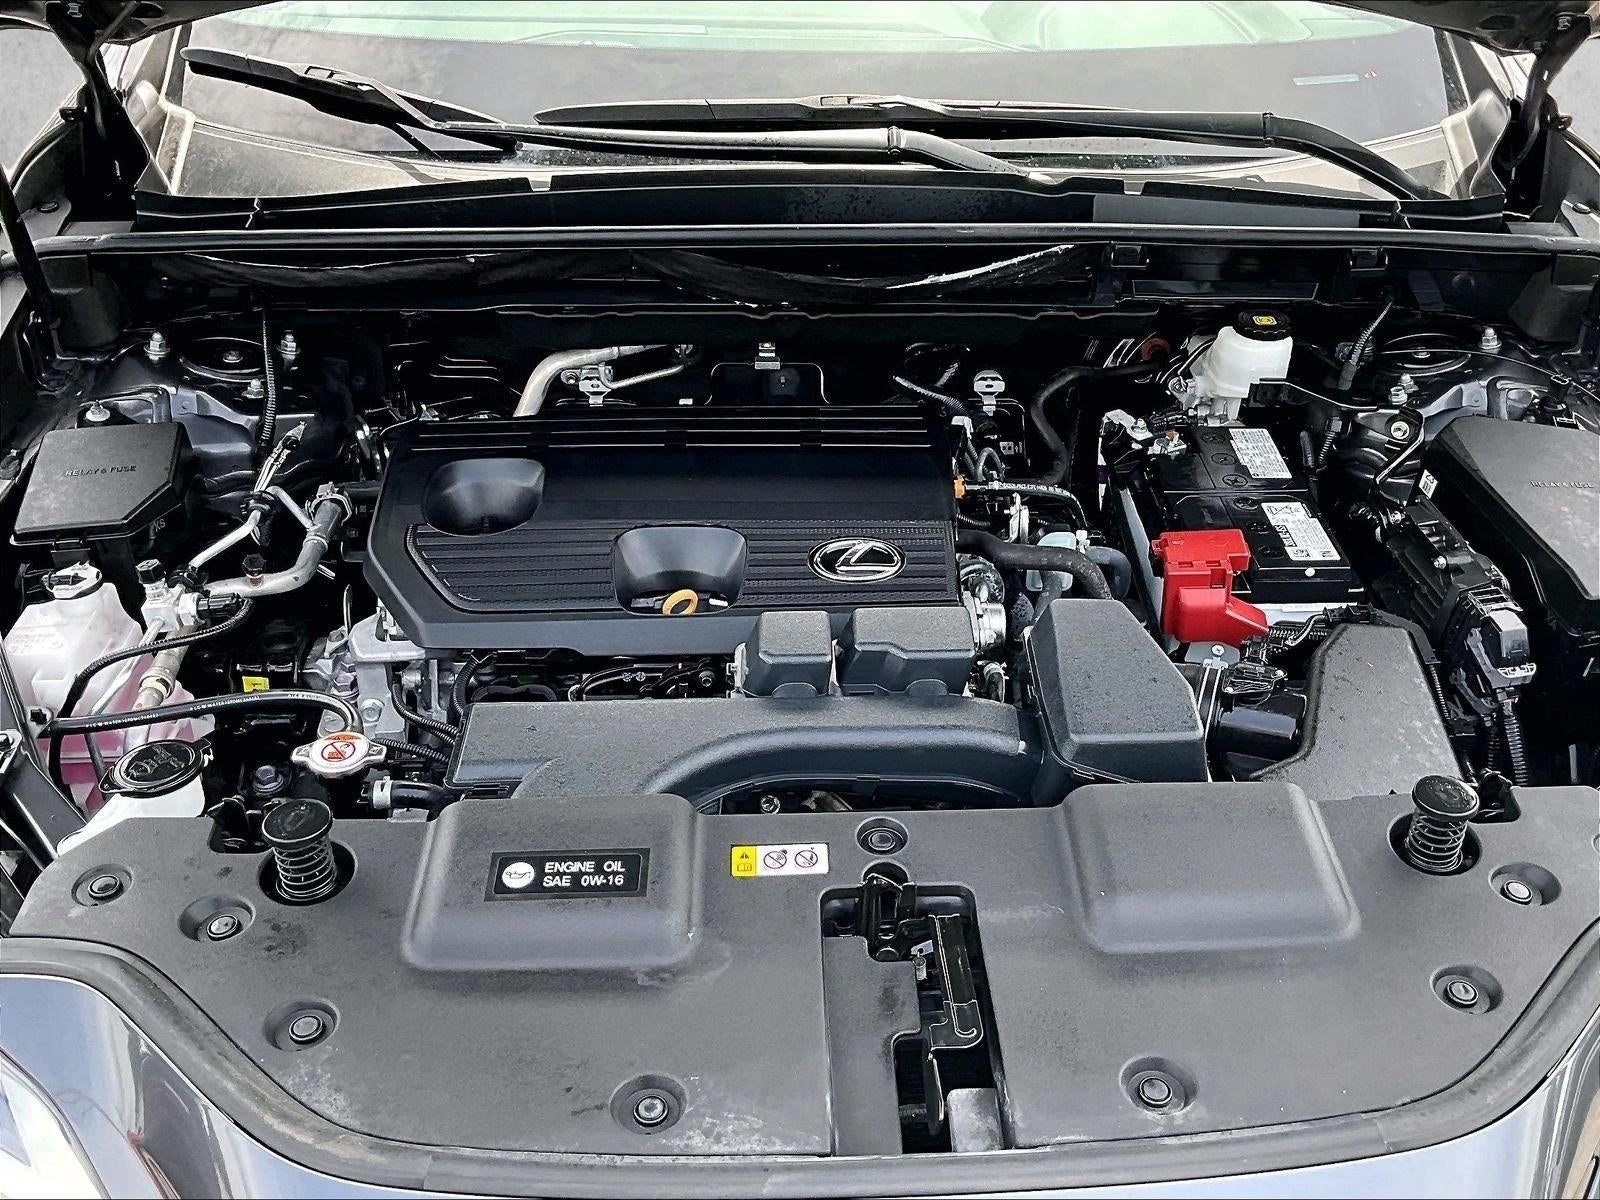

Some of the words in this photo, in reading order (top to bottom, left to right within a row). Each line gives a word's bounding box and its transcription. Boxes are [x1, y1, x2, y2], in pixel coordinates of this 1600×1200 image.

[64, 468, 100, 477] RELAY
[109, 465, 137, 473] FUSE
[544, 861, 595, 873] ENGINE
[603, 860, 626, 872] OIL
[542, 875, 571, 887] SAE
[580, 874, 624, 886] 0W-16
